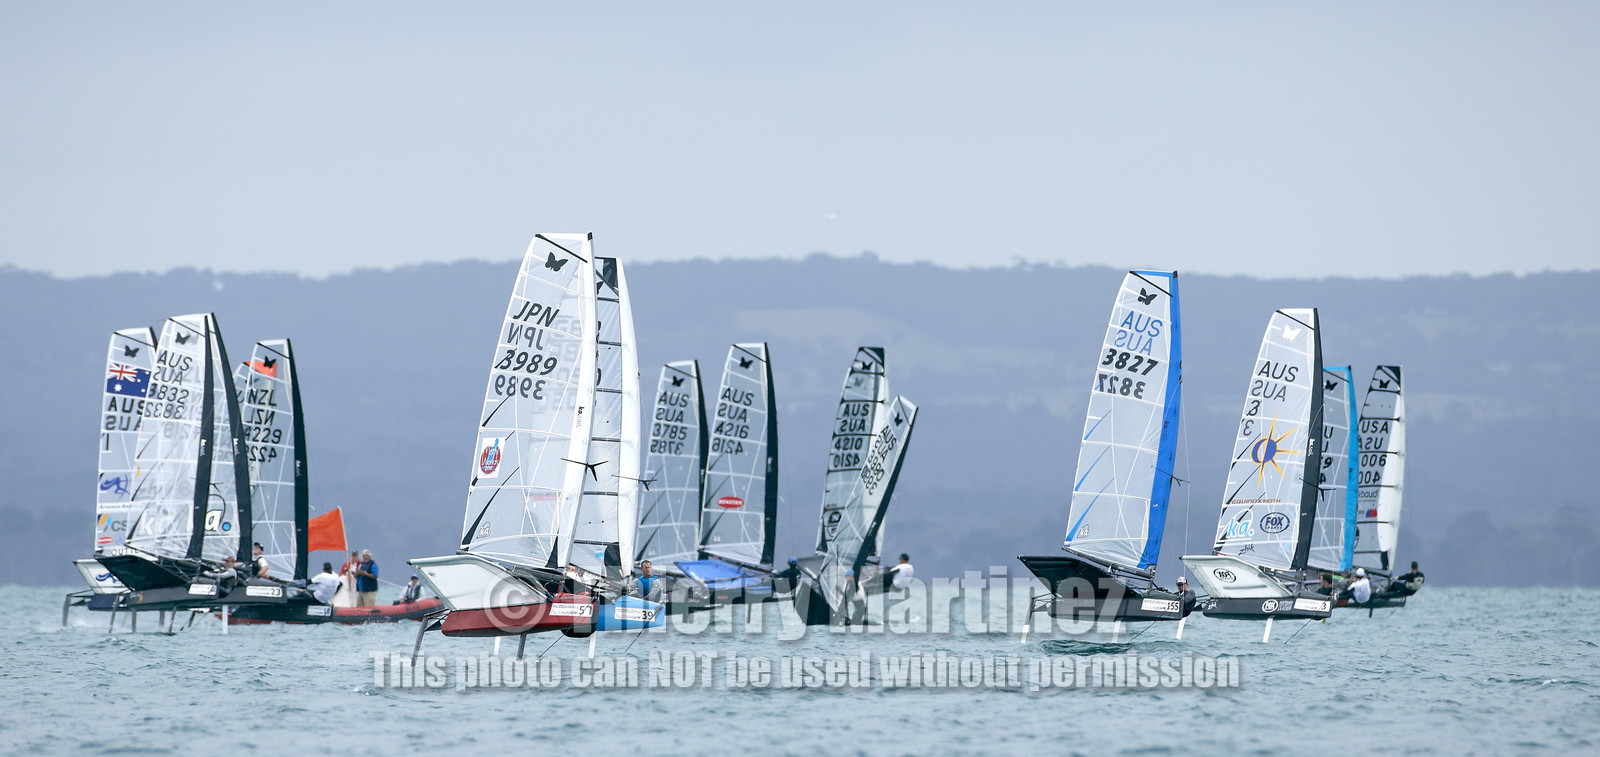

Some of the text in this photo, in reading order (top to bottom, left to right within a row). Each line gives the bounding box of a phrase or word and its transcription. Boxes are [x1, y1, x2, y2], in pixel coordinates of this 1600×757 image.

[512, 301, 560, 327] JPN
[1121, 311, 1163, 337] AUS
[157, 350, 192, 371] AUS
[498, 349, 558, 375] 3989
[1102, 348, 1159, 376] 3827
[1258, 361, 1299, 383] AUS
[148, 382, 190, 405] 3832
[248, 388, 277, 406] NZL
[657, 391, 690, 408] AUS
[721, 387, 755, 407] AUS
[108, 396, 145, 416] AUS
[843, 404, 870, 416] AUS
[652, 422, 688, 440] 3785
[713, 421, 750, 439] 4216
[1361, 420, 1389, 434] USA
[834, 437, 863, 451] 4210
[881, 424, 897, 451] AUS
[1227, 518, 1254, 537] ka.
[1265, 516, 1285, 527] FOX
[1238, 543, 1255, 556] zhik
[579, 604, 593, 615] 57
[642, 610, 654, 620] 39
